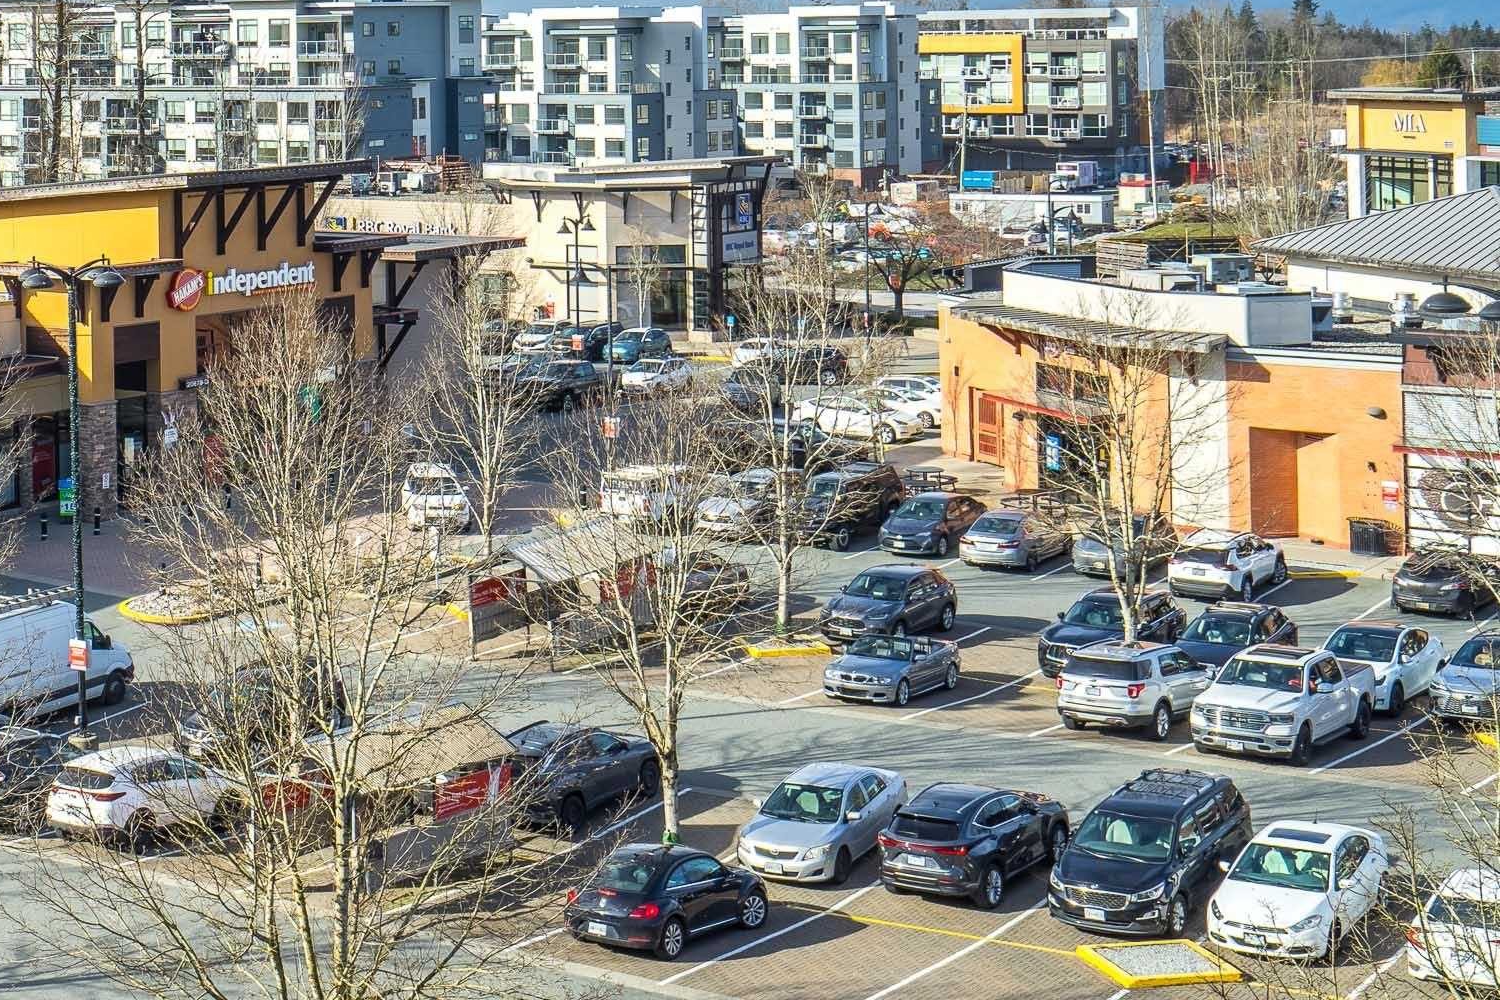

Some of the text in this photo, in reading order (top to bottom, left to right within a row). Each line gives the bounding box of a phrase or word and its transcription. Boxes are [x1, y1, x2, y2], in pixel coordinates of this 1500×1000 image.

[358, 220, 384, 233] RBC
[386, 221, 422, 234] Royal
[173, 272, 205, 304] HAKAM'S
[207, 260, 316, 297] independent
